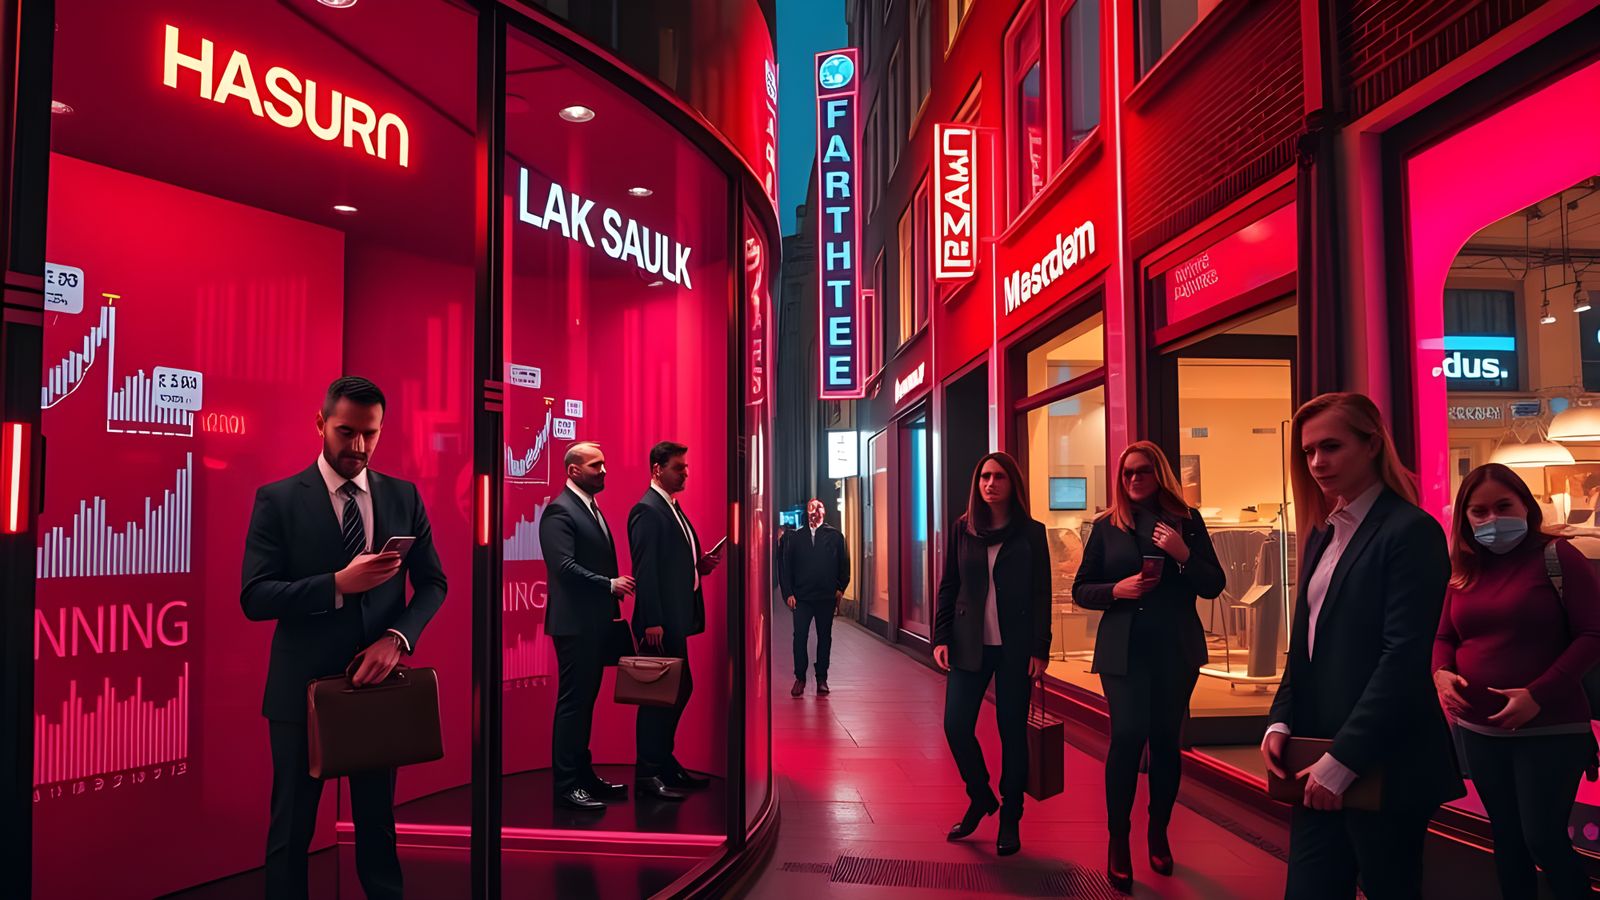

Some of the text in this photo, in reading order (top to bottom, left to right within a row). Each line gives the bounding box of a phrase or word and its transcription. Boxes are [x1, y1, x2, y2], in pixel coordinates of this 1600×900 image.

[519, 167, 692, 290] LAK SAULK
[823, 99, 852, 386] FARTHTEE
